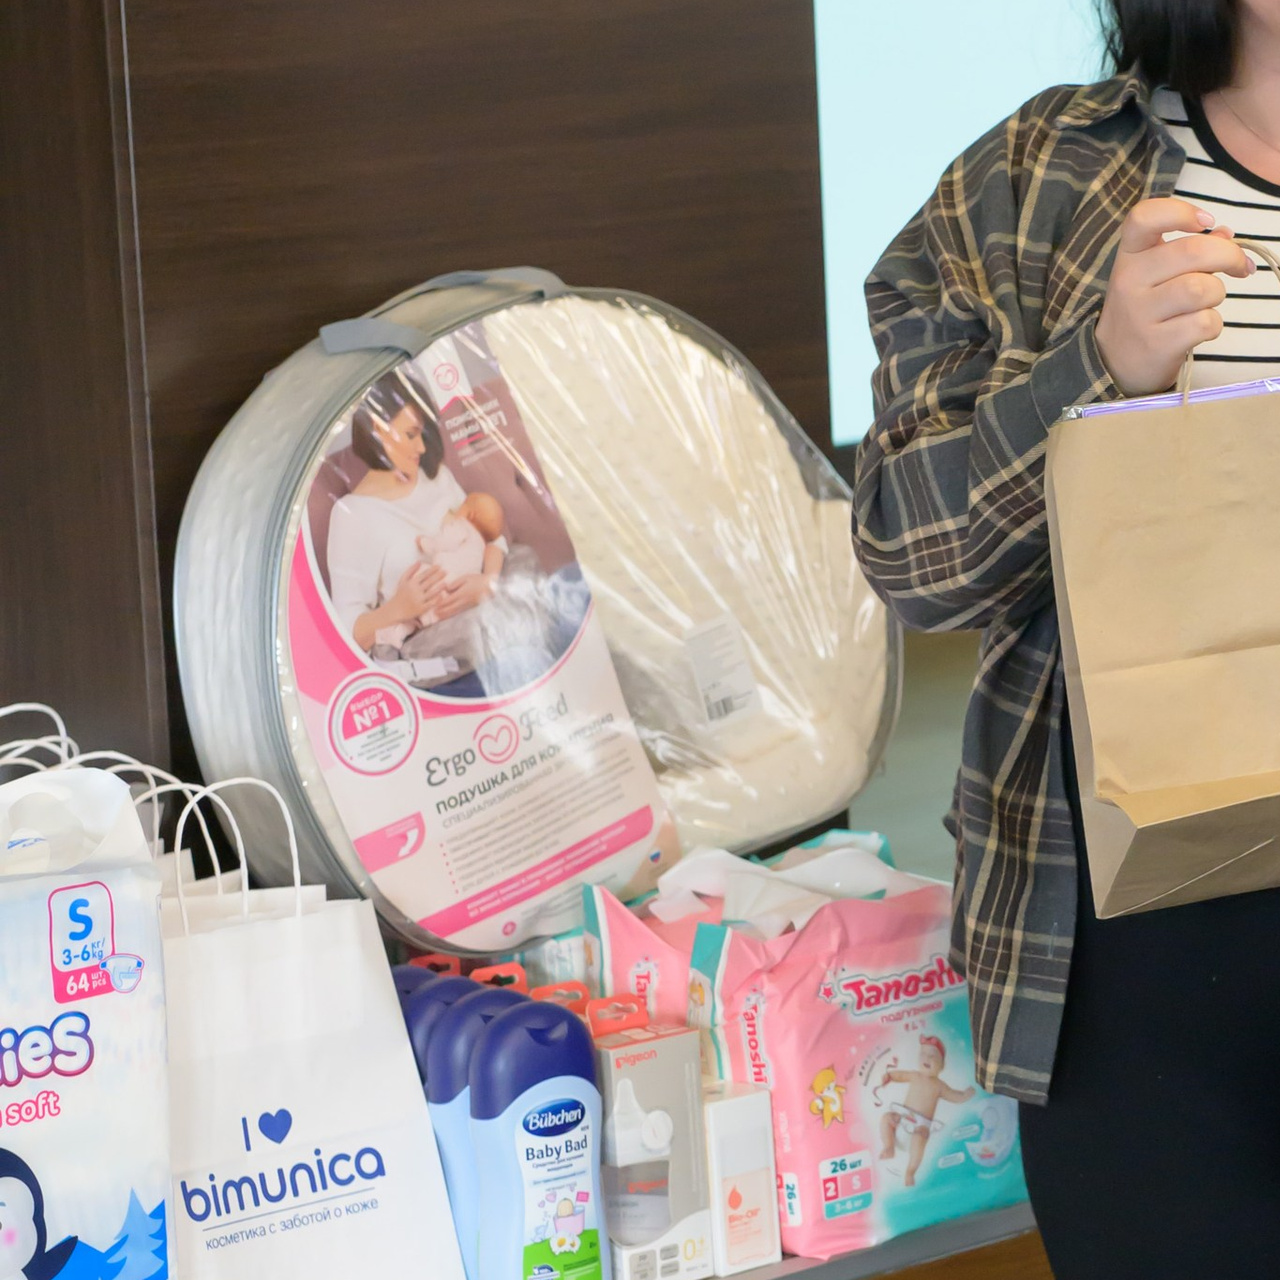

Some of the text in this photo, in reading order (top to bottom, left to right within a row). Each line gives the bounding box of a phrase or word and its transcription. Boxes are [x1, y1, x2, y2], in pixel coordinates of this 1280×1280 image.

[353, 700, 391, 732] №1
[425, 692, 568, 786] Ergo Feed
[436, 770, 509, 815] ПОДУШКА
[511, 755, 538, 780] ДЛЯ
[68, 898, 93, 941] S
[62, 945, 90, 966] 3-6
[92, 949, 103, 960] kg
[66, 974, 90, 995] 64
[92, 978, 107, 990] pcs
[743, 1004, 768, 1083] Tanoshi
[615, 1049, 658, 1069] pigeon
[6, 1091, 60, 1126] soft
[528, 1108, 581, 1131] Bübchen
[241, 1117, 251, 1152] I
[525, 1134, 588, 1161] Baby Bad
[830, 1158, 862, 1174] 26 шт
[180, 1147, 386, 1222] bimunica
[785, 1183, 796, 1200] 26
[825, 1182, 837, 1197] 2
[852, 1176, 862, 1190] S
[205, 1197, 379, 1251] косметика с заботой о коже
